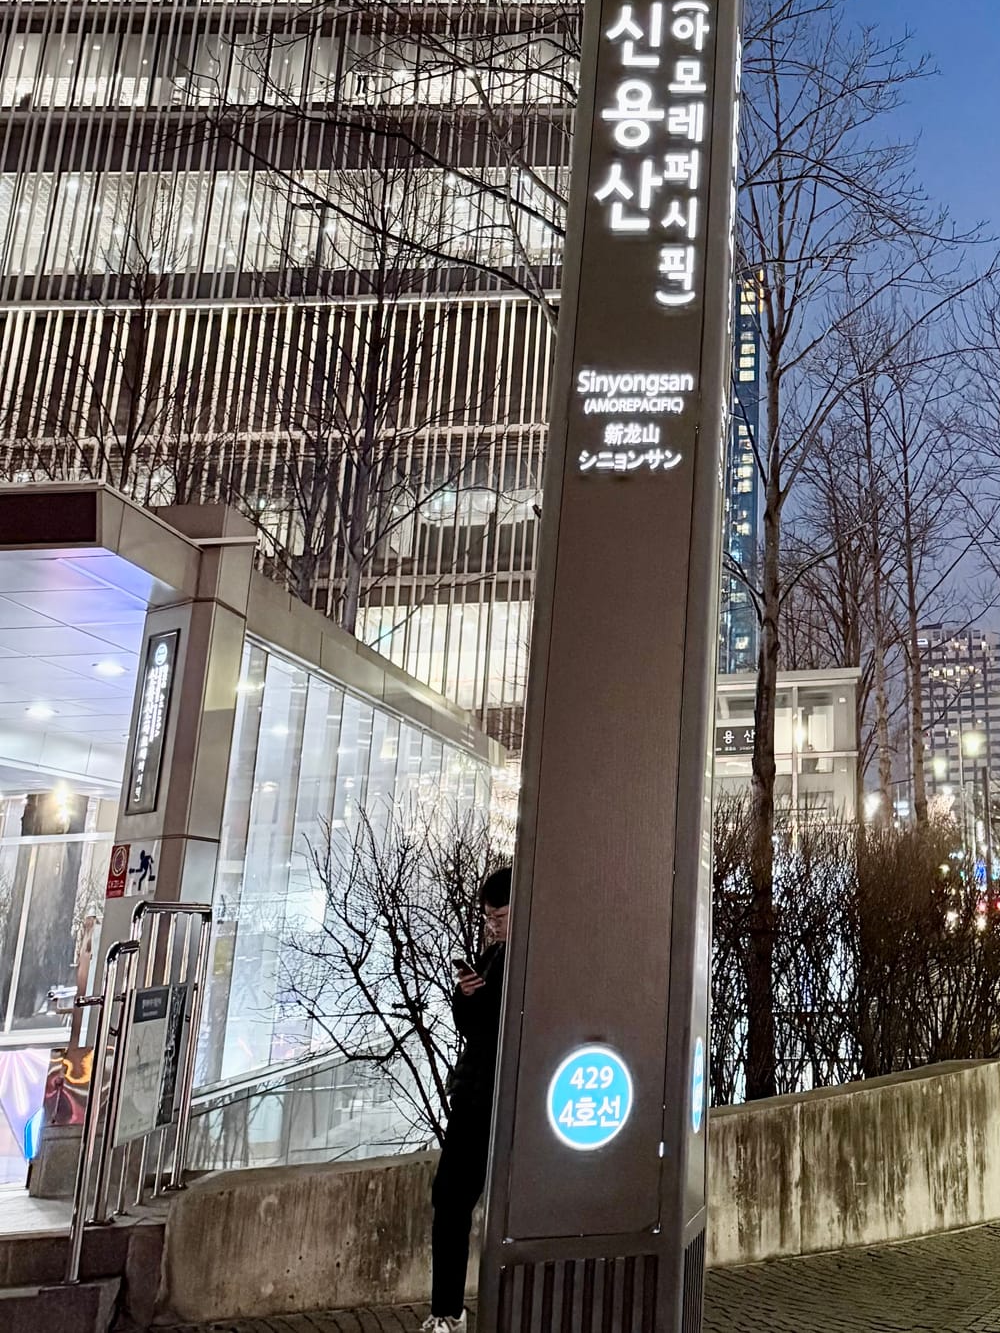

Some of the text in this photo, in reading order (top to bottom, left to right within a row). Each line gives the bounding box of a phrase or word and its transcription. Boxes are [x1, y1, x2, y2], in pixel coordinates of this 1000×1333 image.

[594, 2, 665, 231] 신용산
[577, 370, 694, 397] Sinyongsan
[584, 397, 684, 414] (AMOREPACIFIC)
[604, 423, 660, 446] 新龙山
[578, 448, 682, 471] シニョンサン
[570, 1066, 614, 1090] 429
[559, 1095, 621, 1127] 4호선
